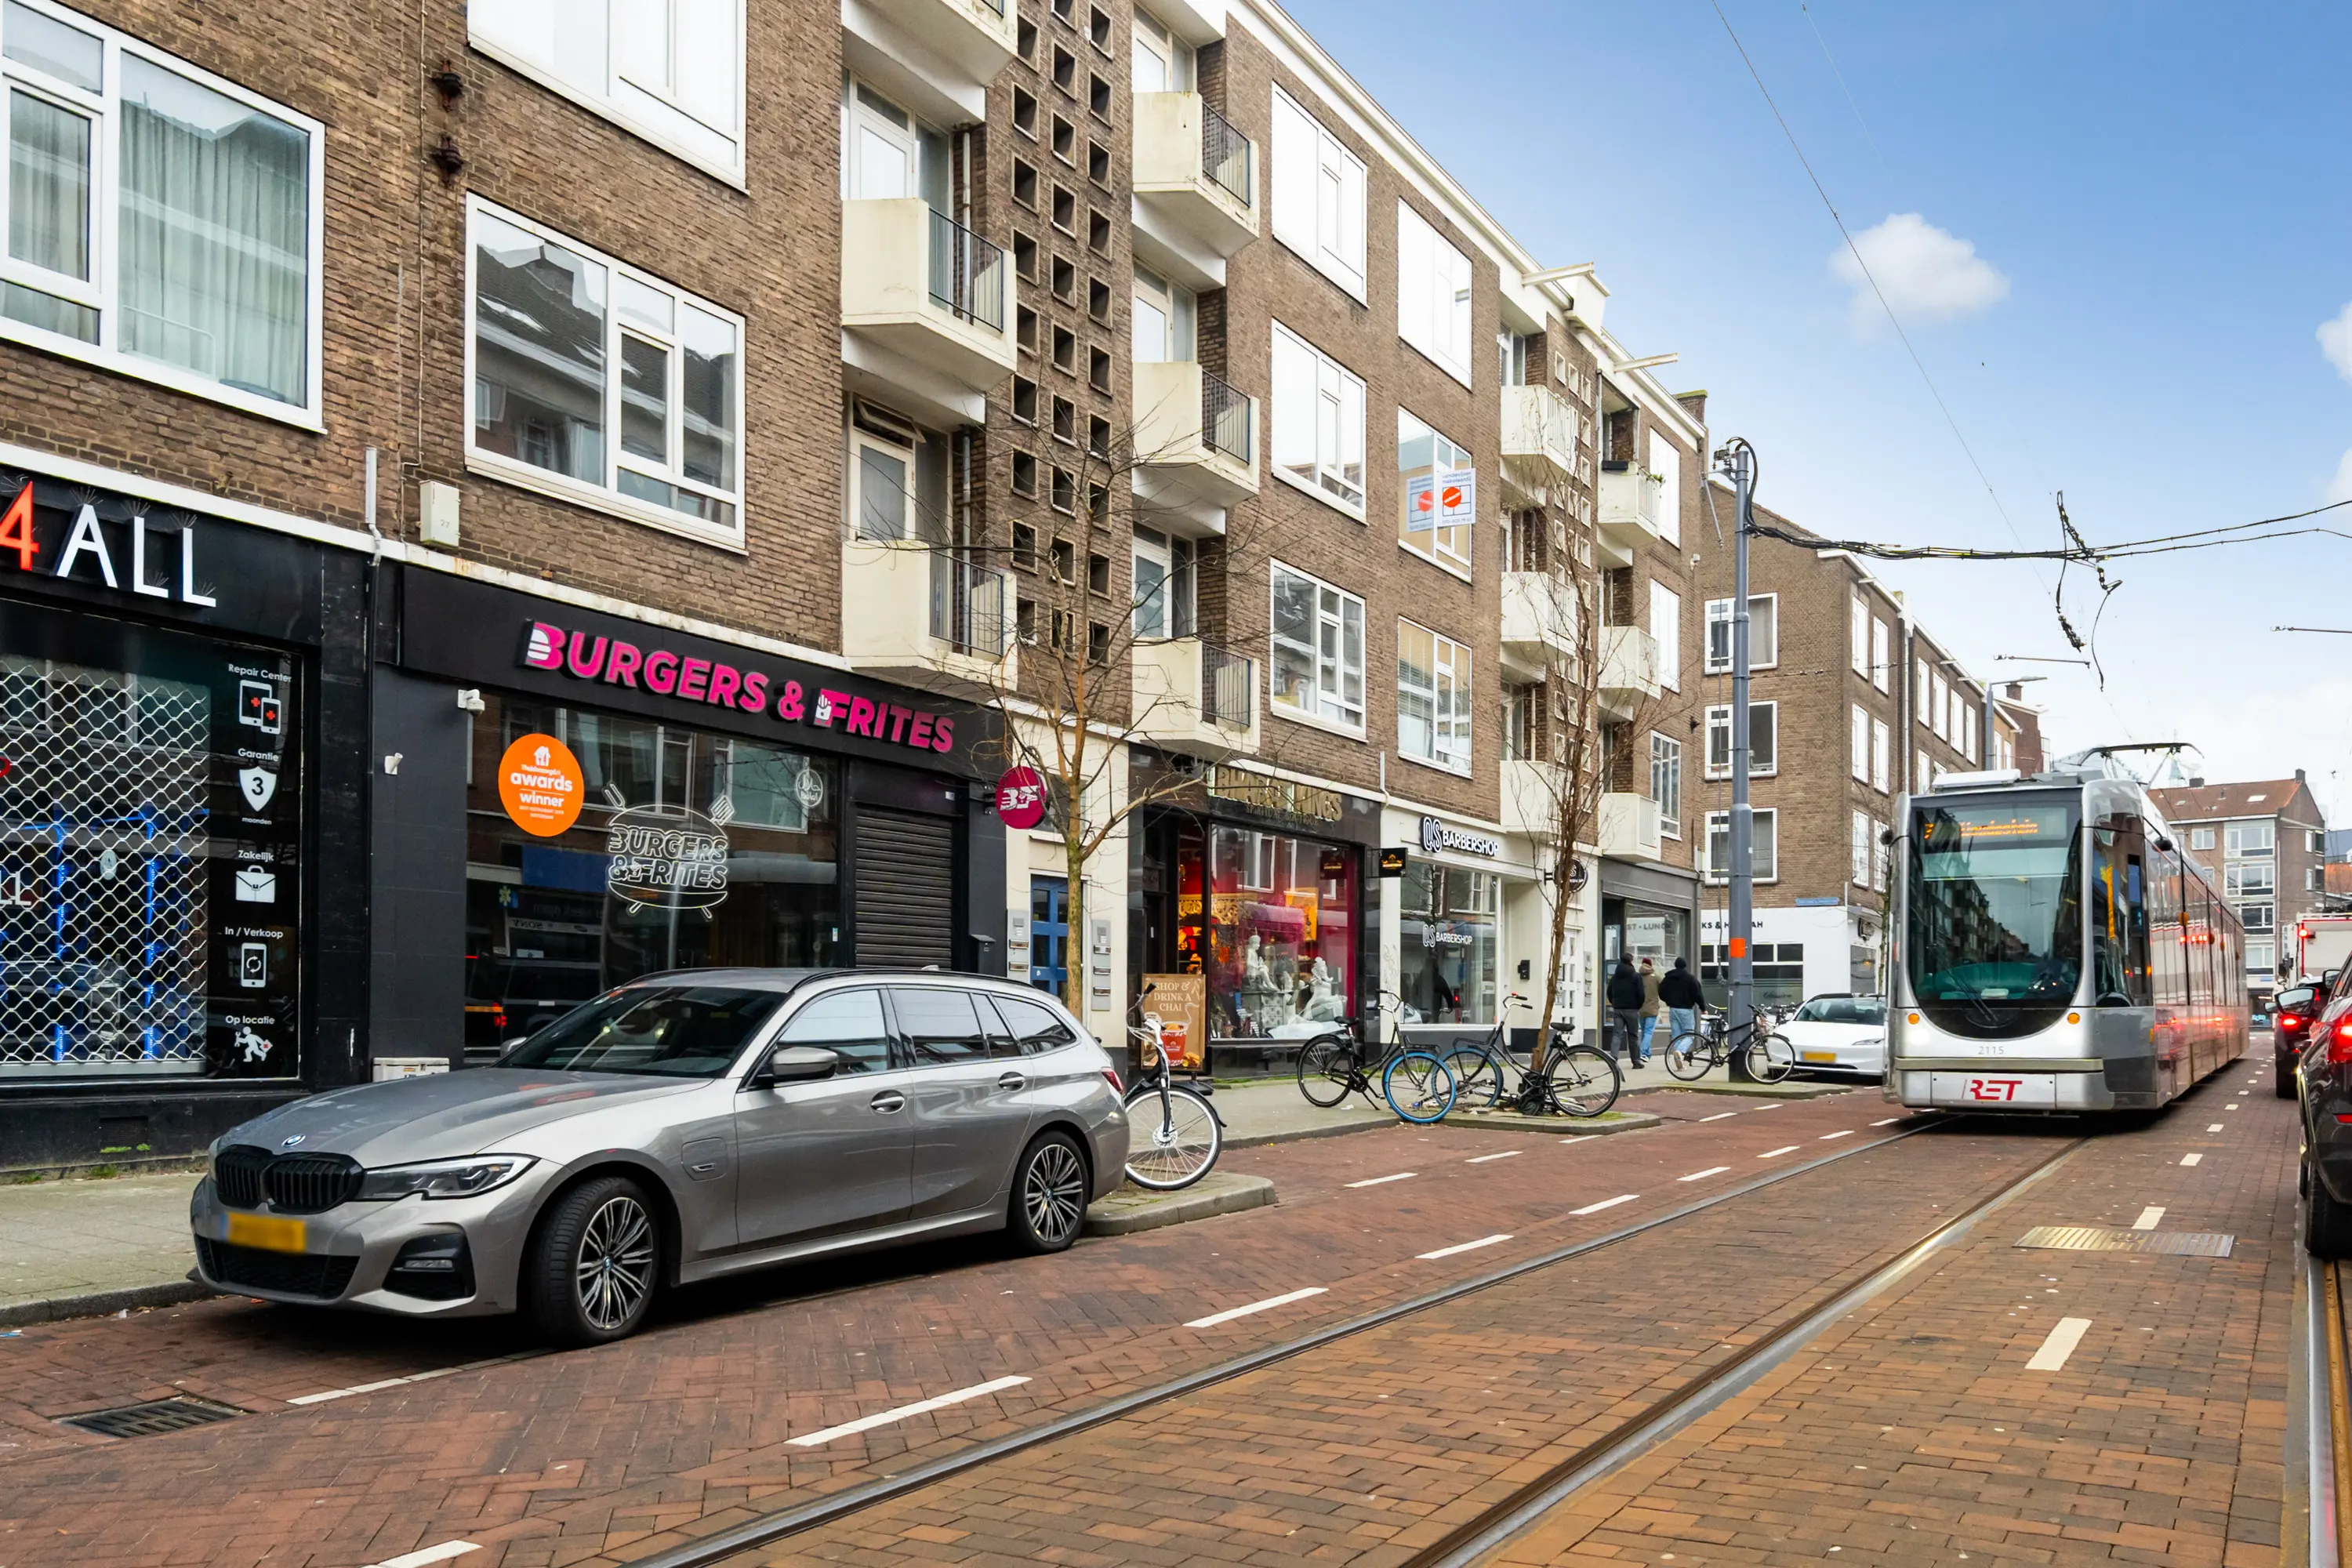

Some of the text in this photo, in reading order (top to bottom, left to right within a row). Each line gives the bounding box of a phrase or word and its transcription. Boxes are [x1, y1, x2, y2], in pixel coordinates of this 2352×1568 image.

[228, 663, 292, 683] Repair Center
[524, 622, 955, 753] BURGERS & FRITES
[238, 748, 279, 762] Garantie
[251, 776, 264, 796] 3
[510, 772, 573, 792] awards
[519, 792, 564, 808] winner
[241, 817, 272, 826] maanden
[608, 823, 729, 864] BURGERS
[1443, 830, 1499, 857] BARBERSHOP
[238, 850, 274, 862] Zakelijk
[1724, 920, 1763, 929] HAH
[225, 927, 234, 935] In
[243, 927, 283, 939] Verkoop
[1436, 931, 1472, 945] BARBERSHOP
[1156, 982, 1190, 991] SHOP &
[1154, 993, 1192, 1001] DRINK A
[1160, 1003, 1182, 1011] CHAI
[225, 1014, 275, 1025] Op locatie
[1978, 1046, 2005, 1055] 2115
[1969, 1079, 2023, 1101] RET
